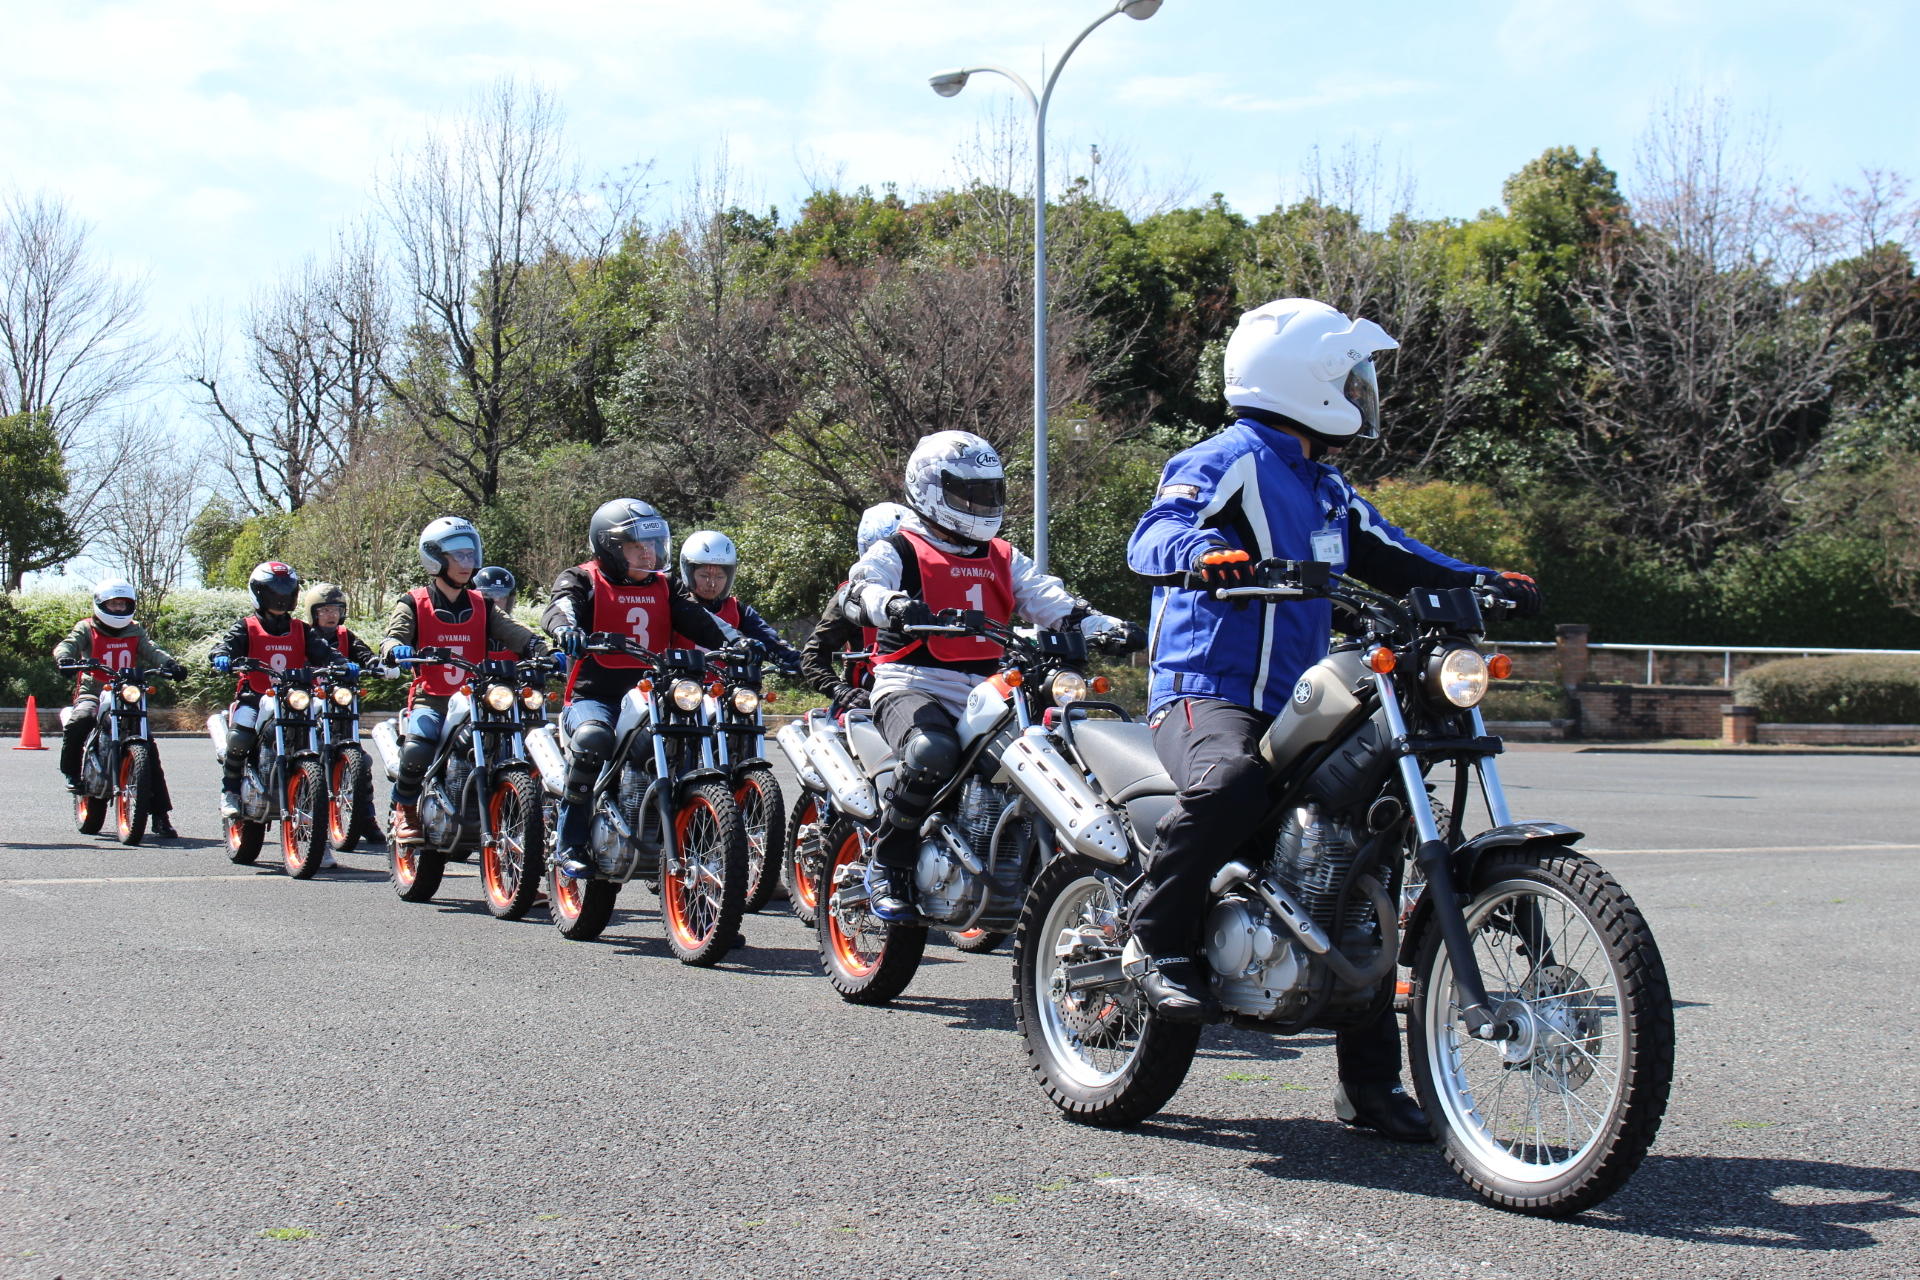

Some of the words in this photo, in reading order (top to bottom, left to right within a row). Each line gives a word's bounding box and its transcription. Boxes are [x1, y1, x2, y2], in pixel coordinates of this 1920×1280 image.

[961, 568, 995, 581] YAMAHA
[625, 595, 656, 604] YAMAHA
[626, 607, 650, 650] 3
[445, 634, 471, 642] YAMAHA
[102, 649, 132, 669] 10
[443, 645, 466, 686] 5
